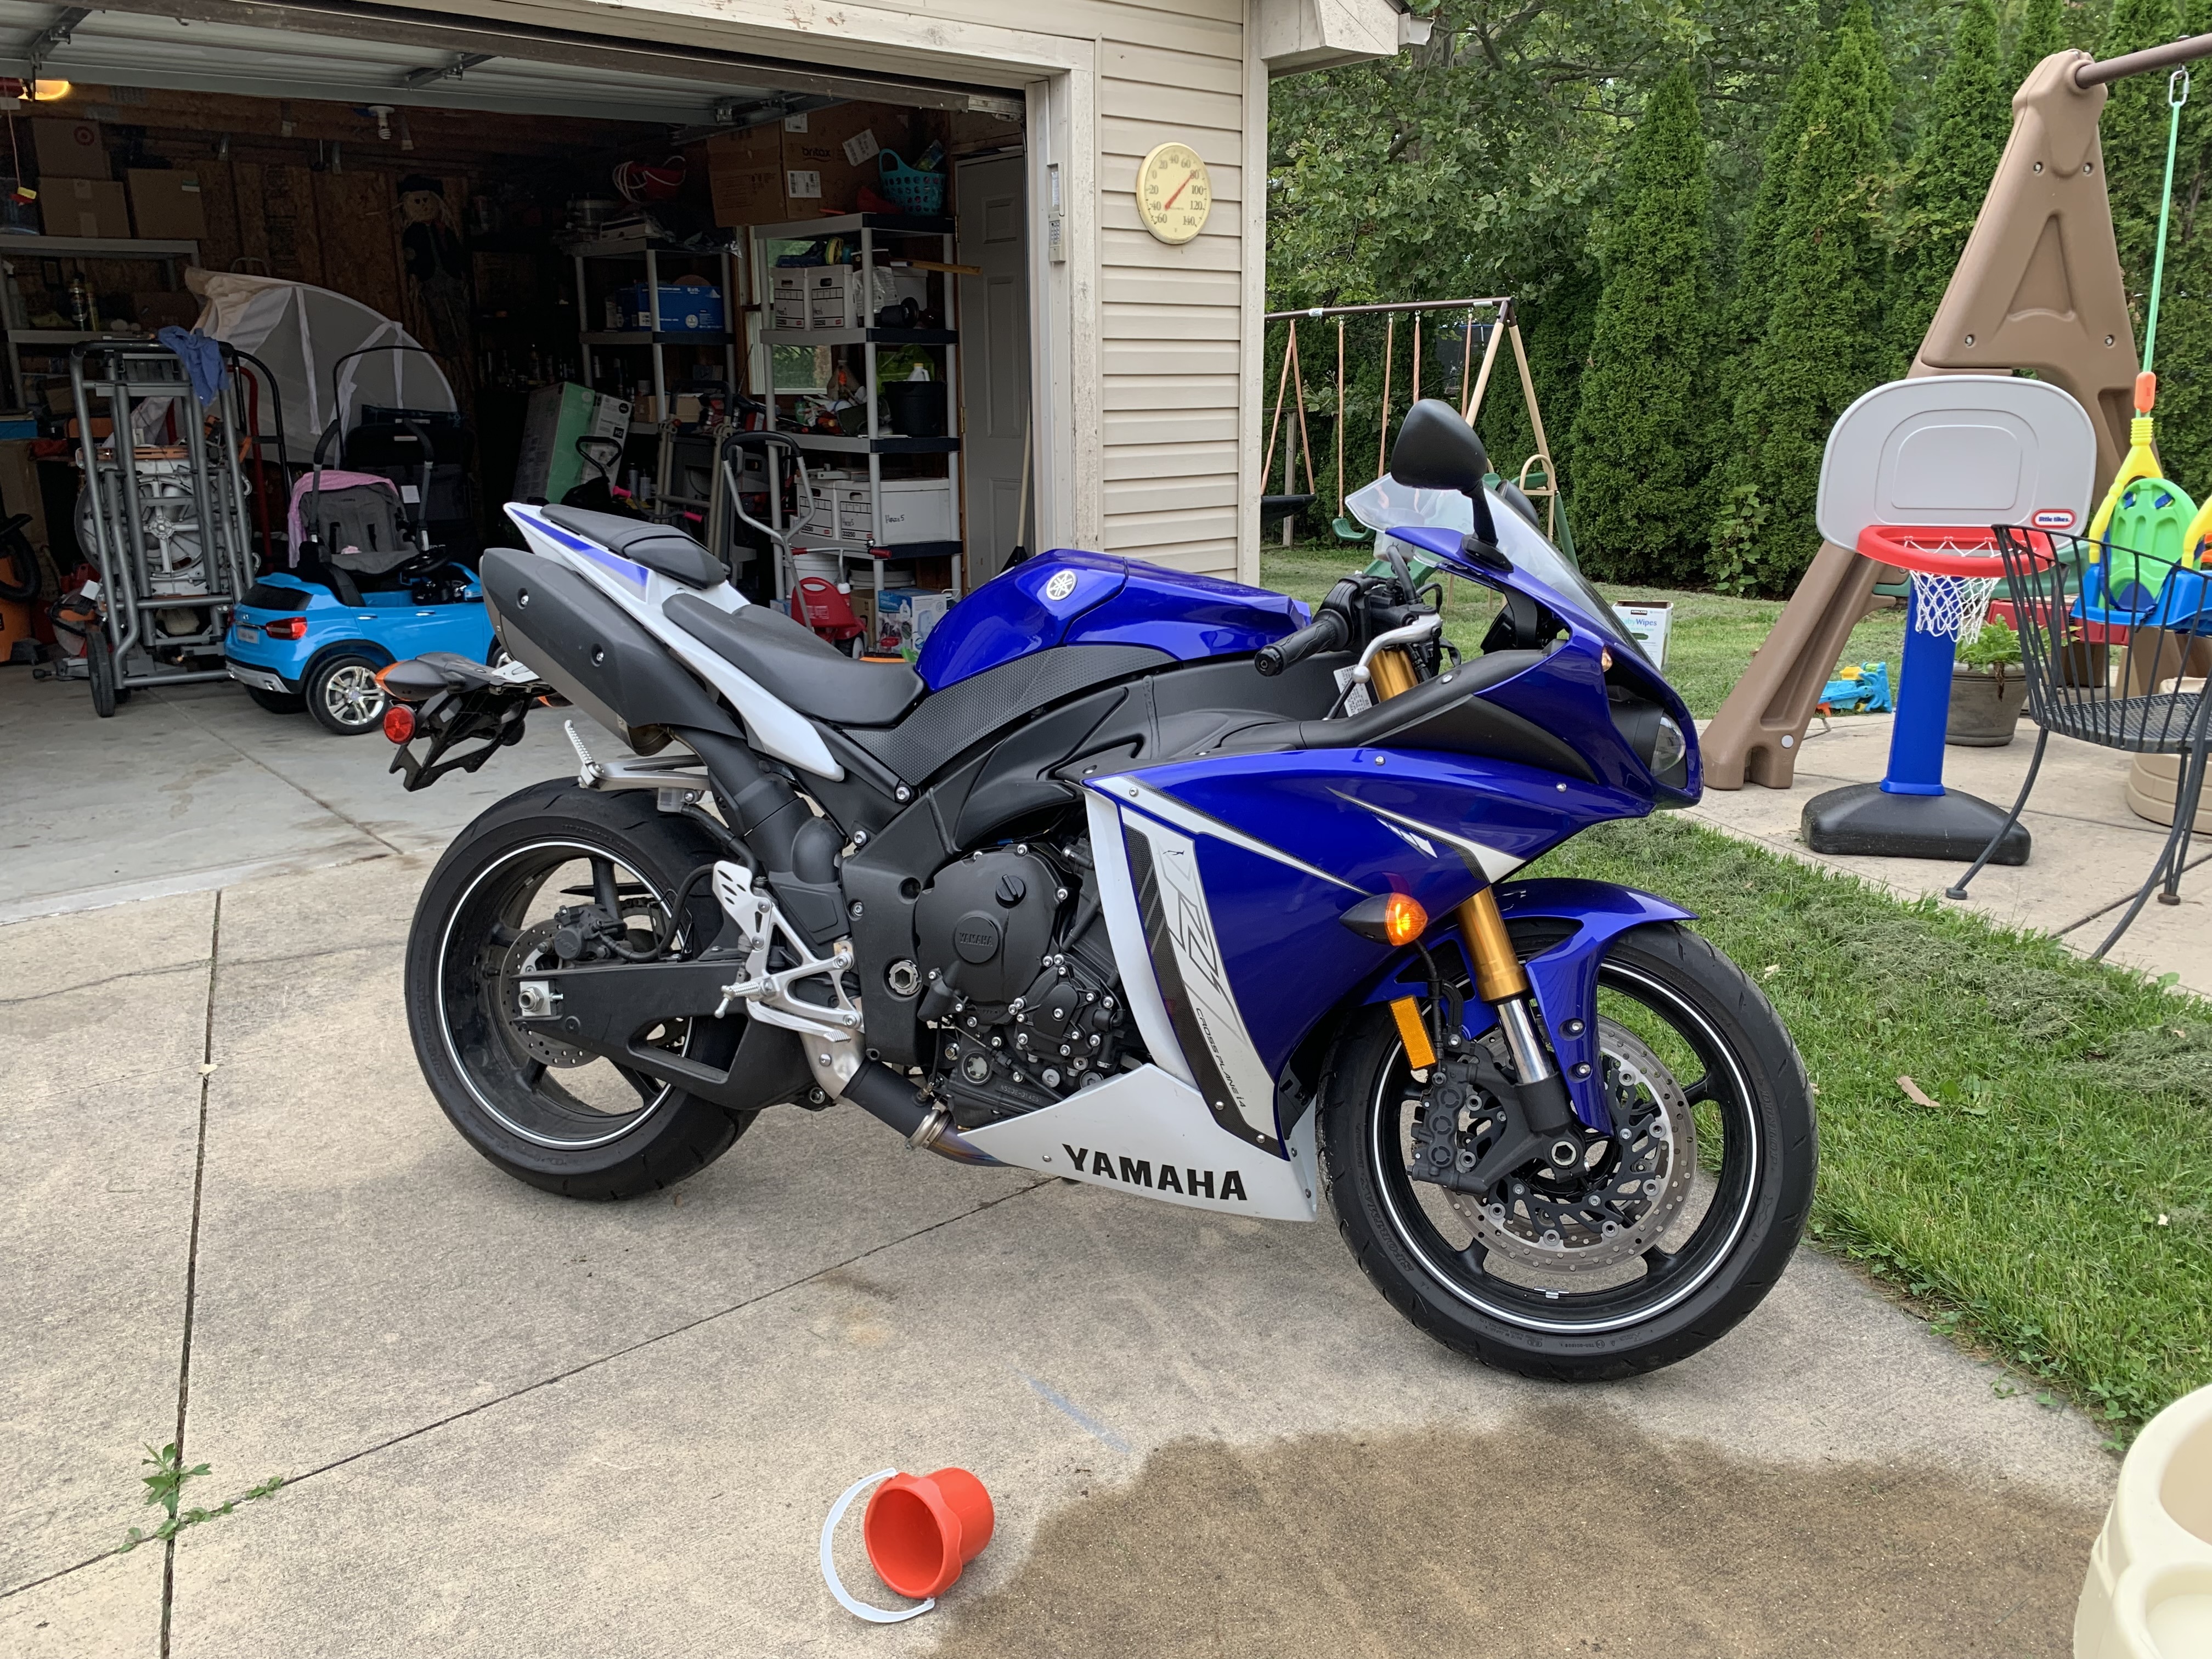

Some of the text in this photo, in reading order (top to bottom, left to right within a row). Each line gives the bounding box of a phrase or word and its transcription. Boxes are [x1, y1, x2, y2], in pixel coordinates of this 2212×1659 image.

[1169, 154, 1179, 164] 40
[1181, 159, 1191, 168] 60
[1159, 160, 1168, 170] 20
[1192, 184, 1204, 195] 100
[1189, 200, 1203, 211] 120
[1182, 216, 1195, 225] 140
[960, 933, 993, 947] YAMAHA
[1760, 1090, 1778, 1165] DUNLOP
[1062, 1143, 1248, 1201] YAMAHA
[1360, 1176, 1414, 1272] SPORTMAX
